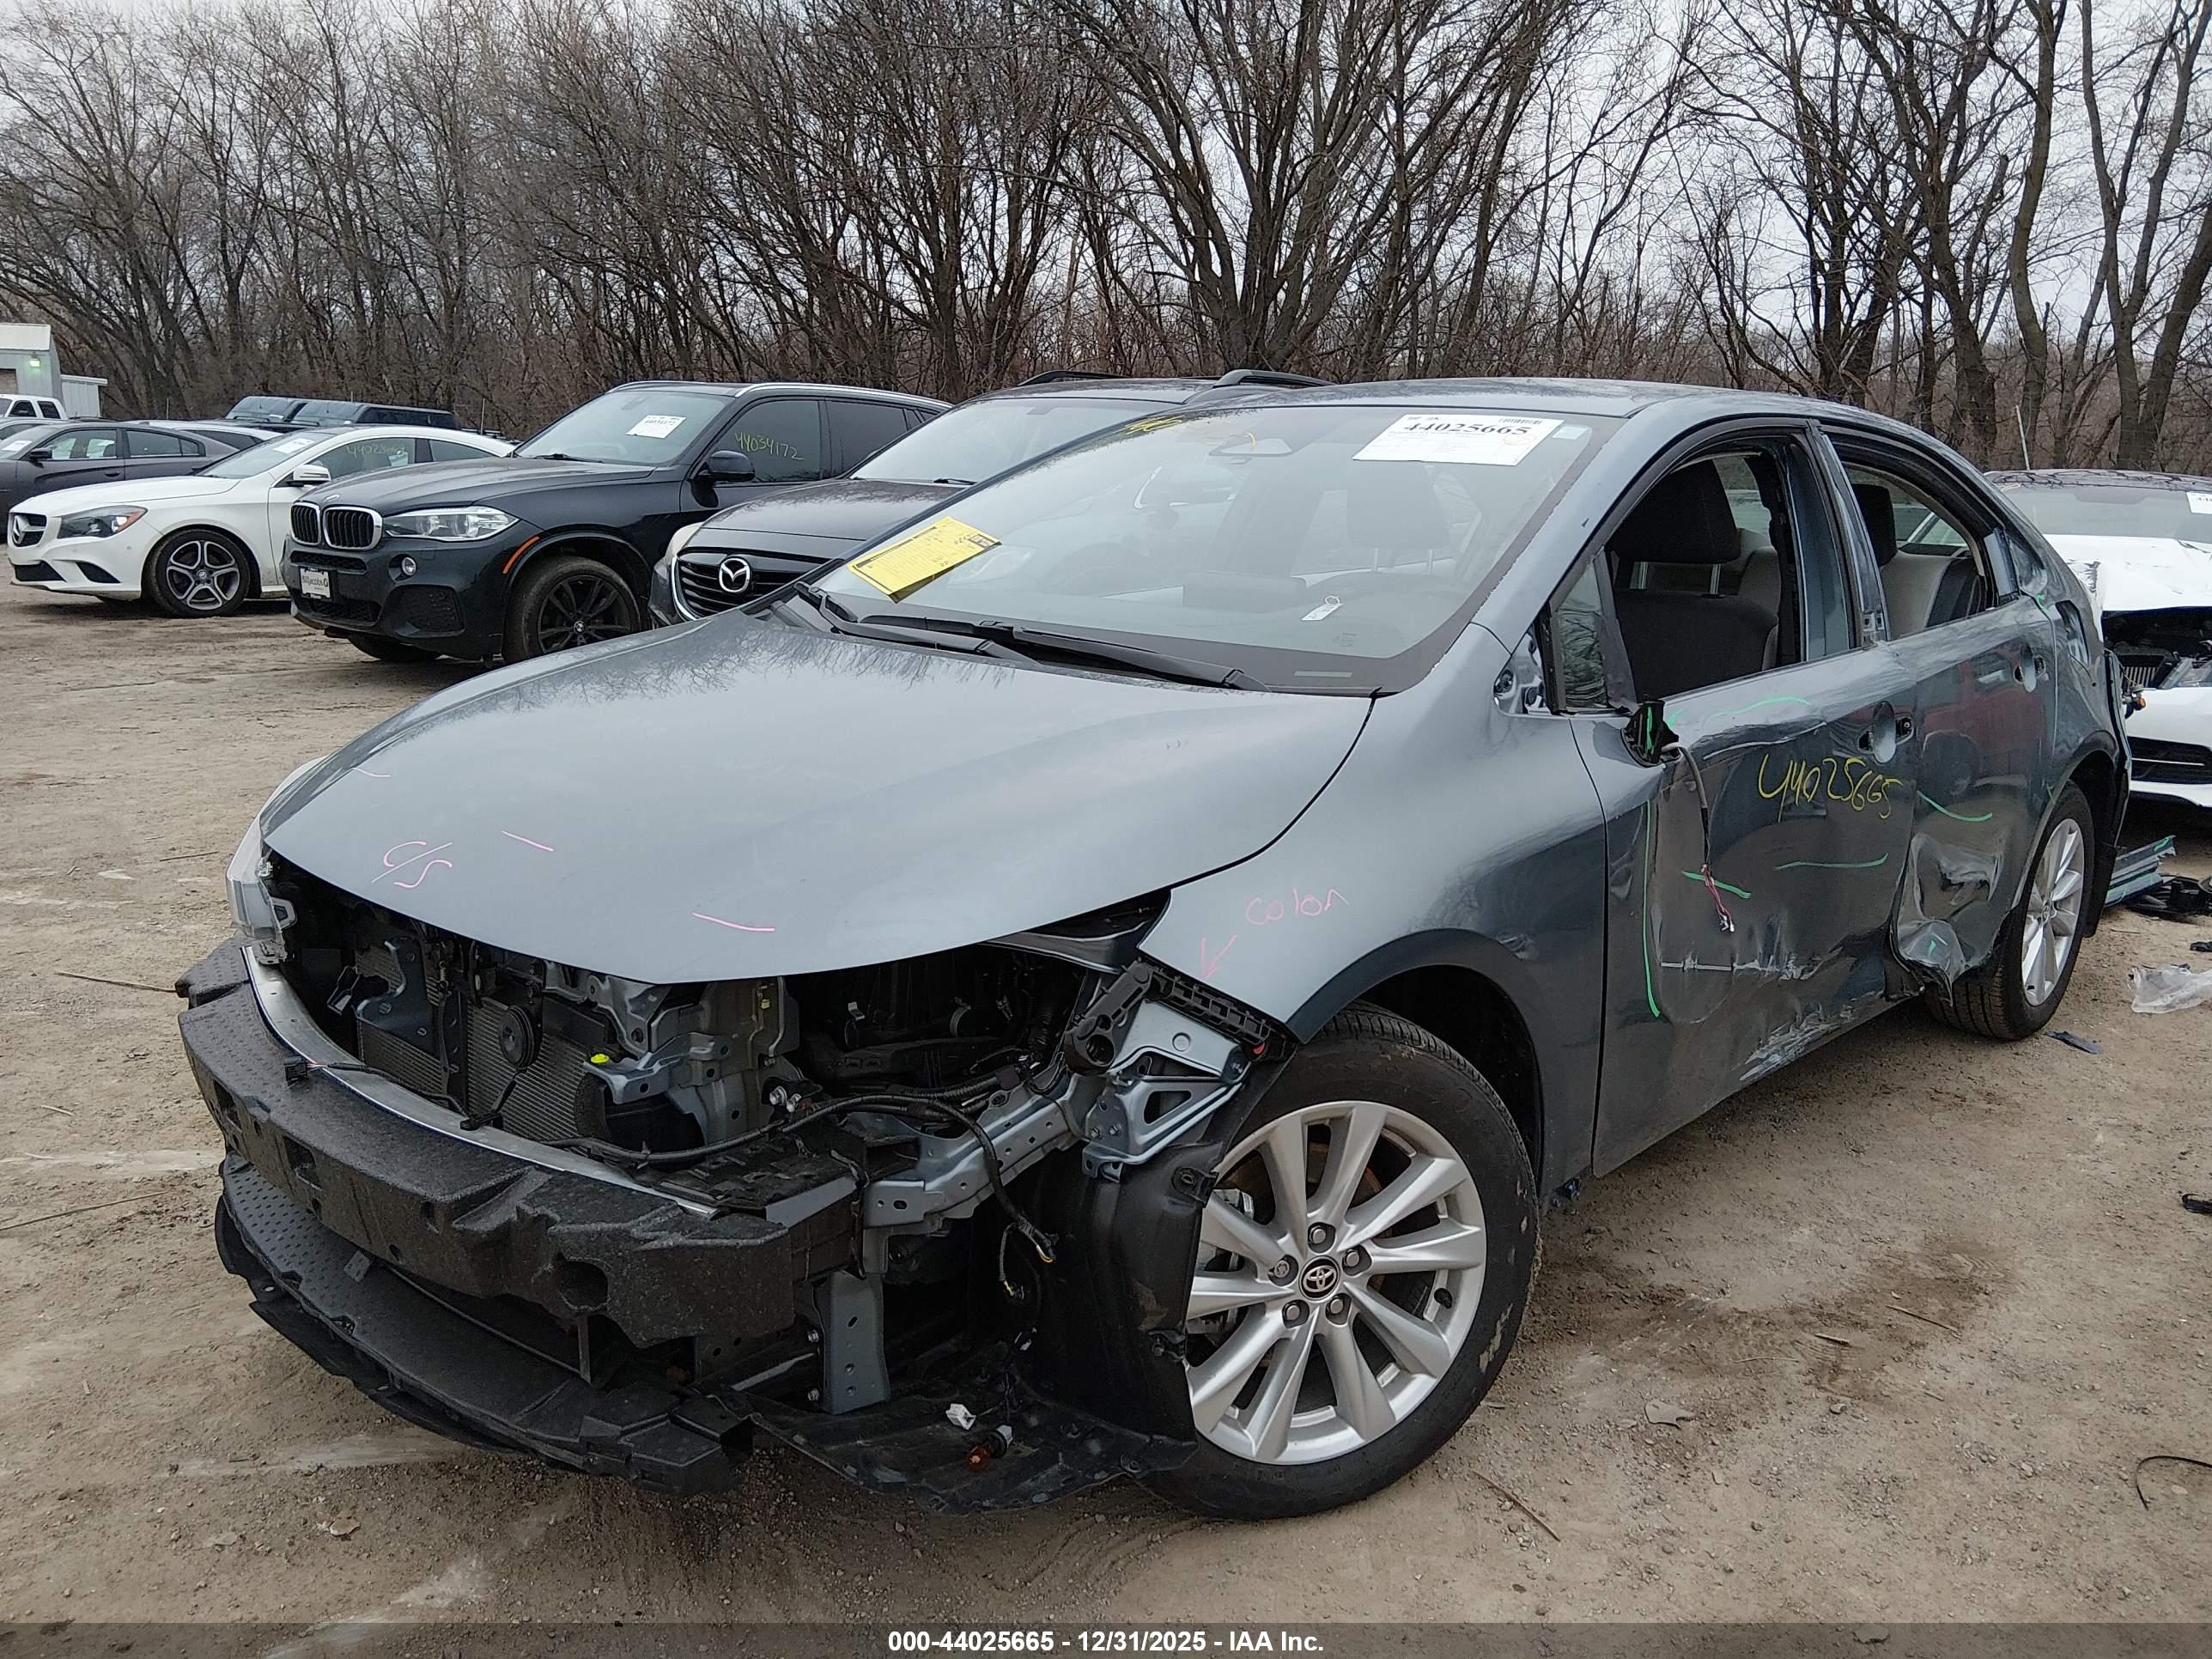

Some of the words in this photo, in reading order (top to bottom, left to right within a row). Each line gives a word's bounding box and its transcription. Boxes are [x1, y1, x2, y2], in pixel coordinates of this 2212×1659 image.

[1402, 422, 1534, 435] 44025665
[734, 432, 805, 460] 44034172
[1758, 753, 1904, 823] 44025665
